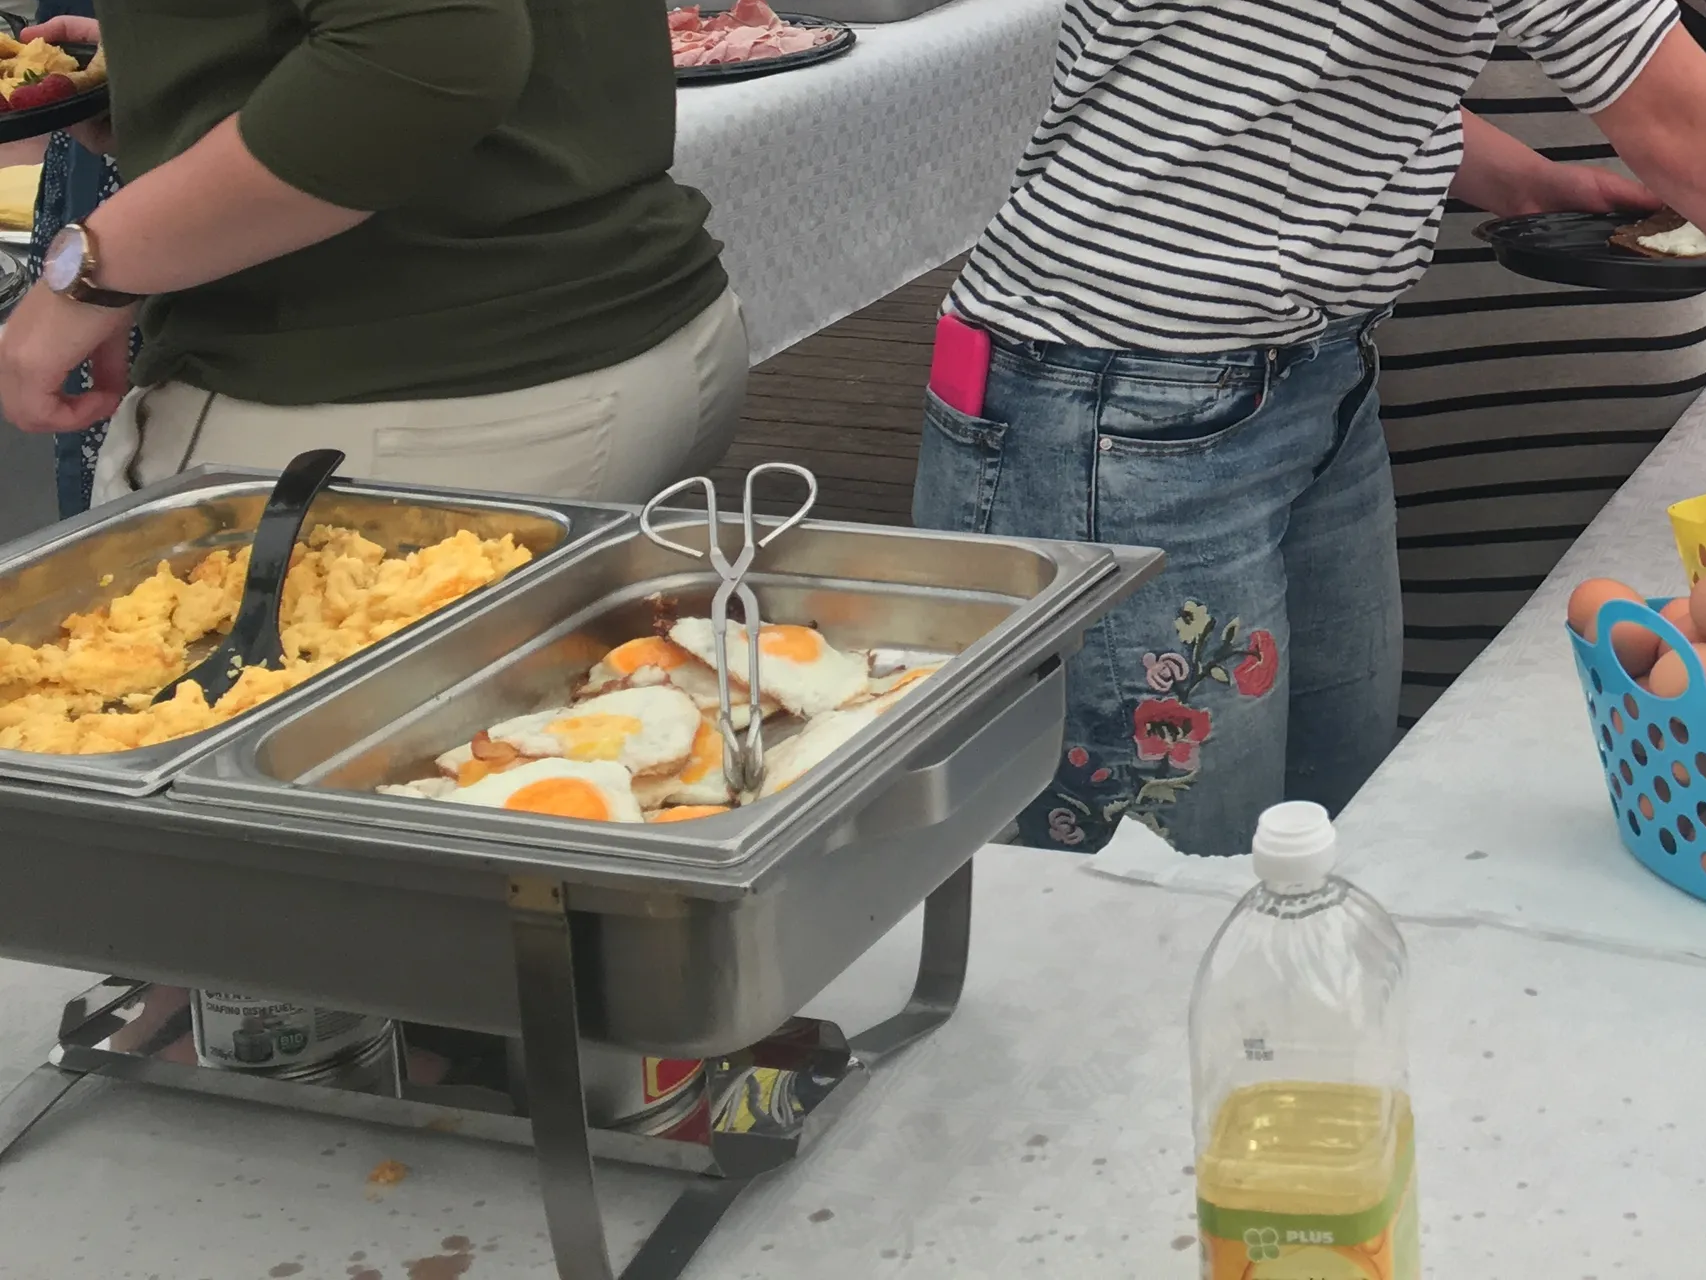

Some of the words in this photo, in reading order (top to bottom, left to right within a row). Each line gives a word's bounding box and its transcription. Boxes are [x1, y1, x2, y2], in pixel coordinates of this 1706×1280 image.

[206, 1001, 240, 1016] CHAFING
[268, 1002, 295, 1015] FUEL
[1286, 1230, 1335, 1244] PLUS
